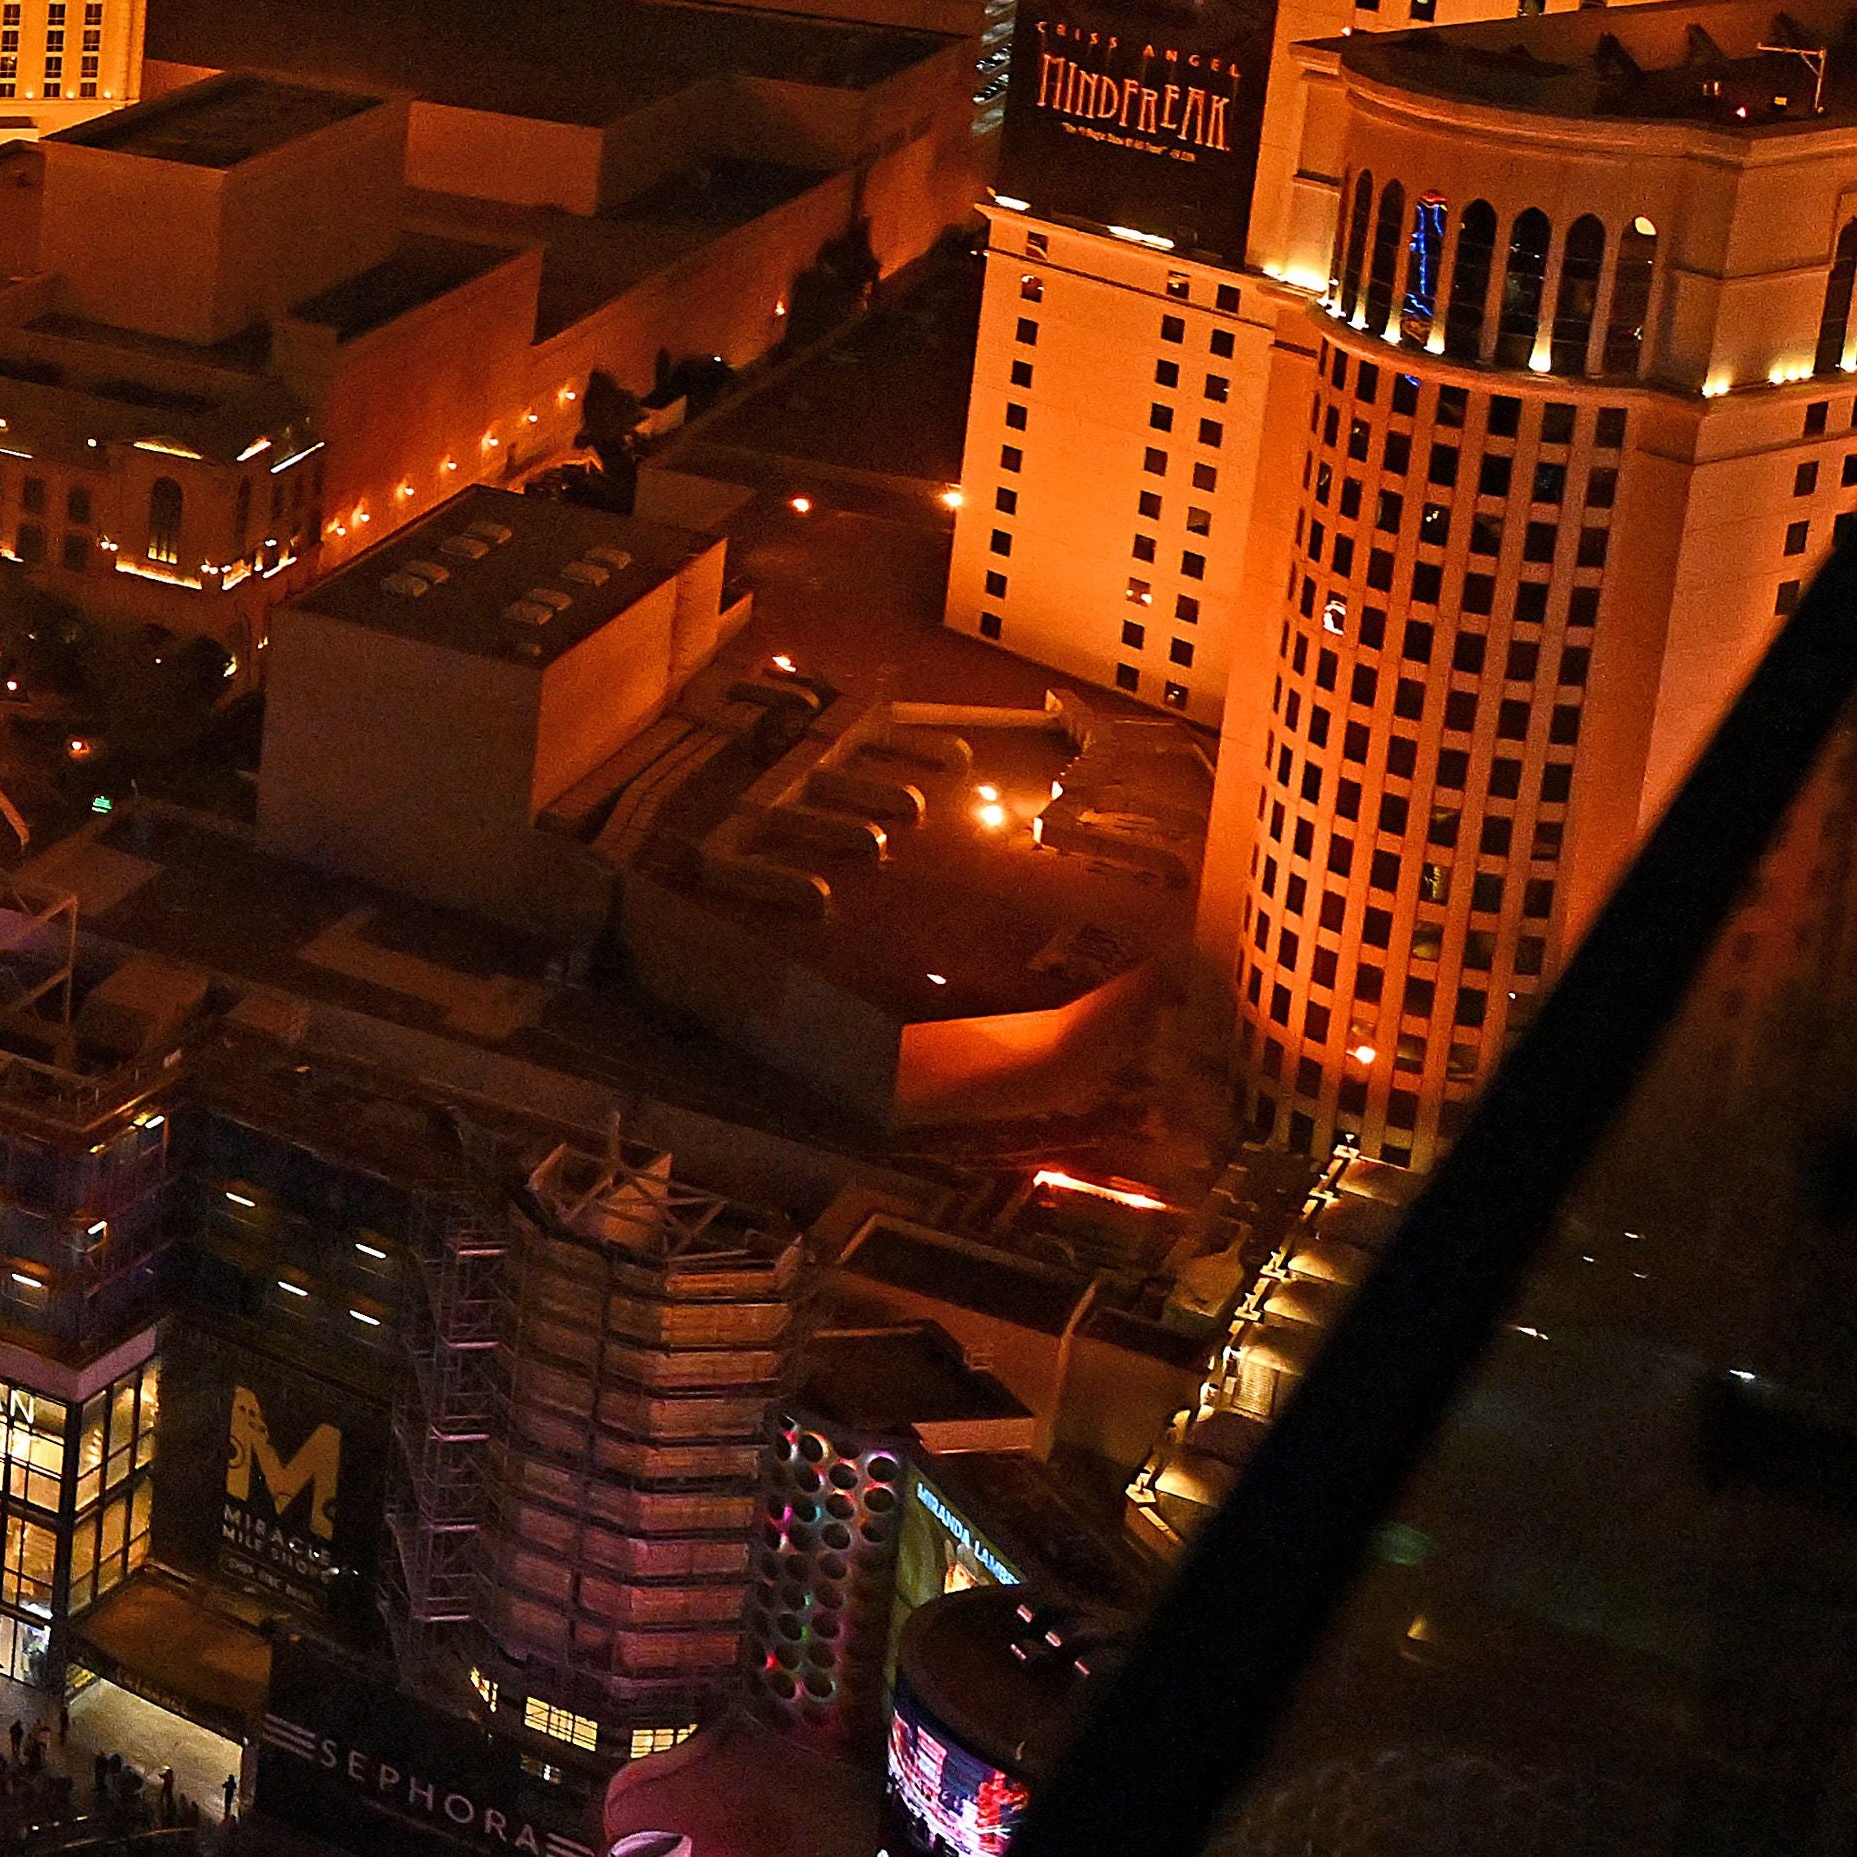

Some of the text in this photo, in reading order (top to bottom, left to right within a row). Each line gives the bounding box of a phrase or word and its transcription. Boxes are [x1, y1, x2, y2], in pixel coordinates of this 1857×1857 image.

[1036, 20, 1242, 78] CRISS ANGEL
[1036, 51, 1231, 153] MINDFREAK
[319, 1738, 540, 1856] SEPHORA
